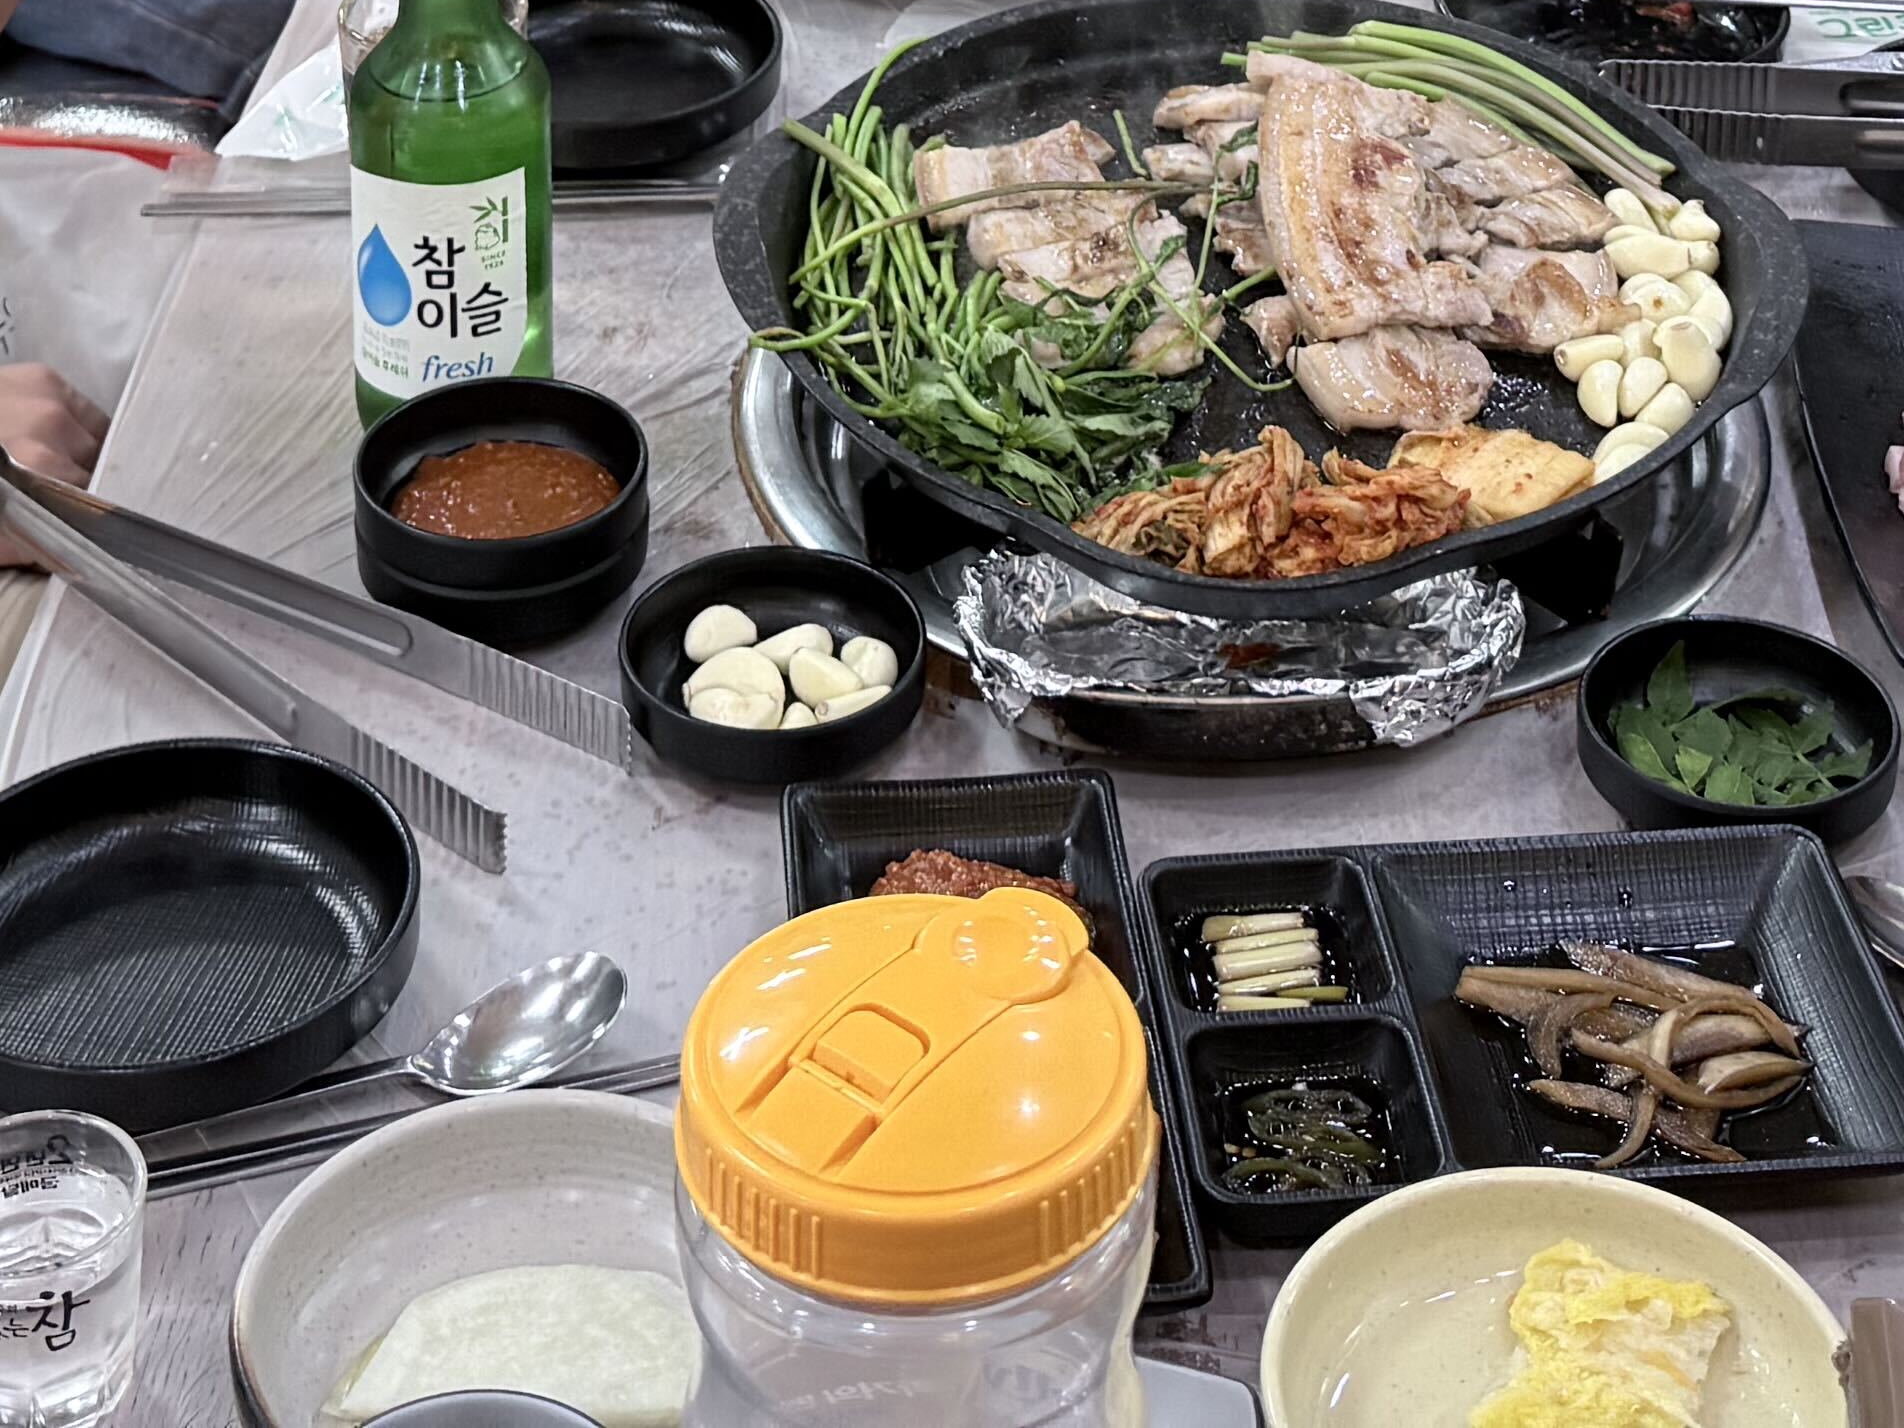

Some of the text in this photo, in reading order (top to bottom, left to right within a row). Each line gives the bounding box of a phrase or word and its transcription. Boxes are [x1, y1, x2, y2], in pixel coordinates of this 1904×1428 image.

[412, 235, 466, 290] 참
[417, 281, 509, 339] 이슬
[422, 351, 494, 382] fresh
